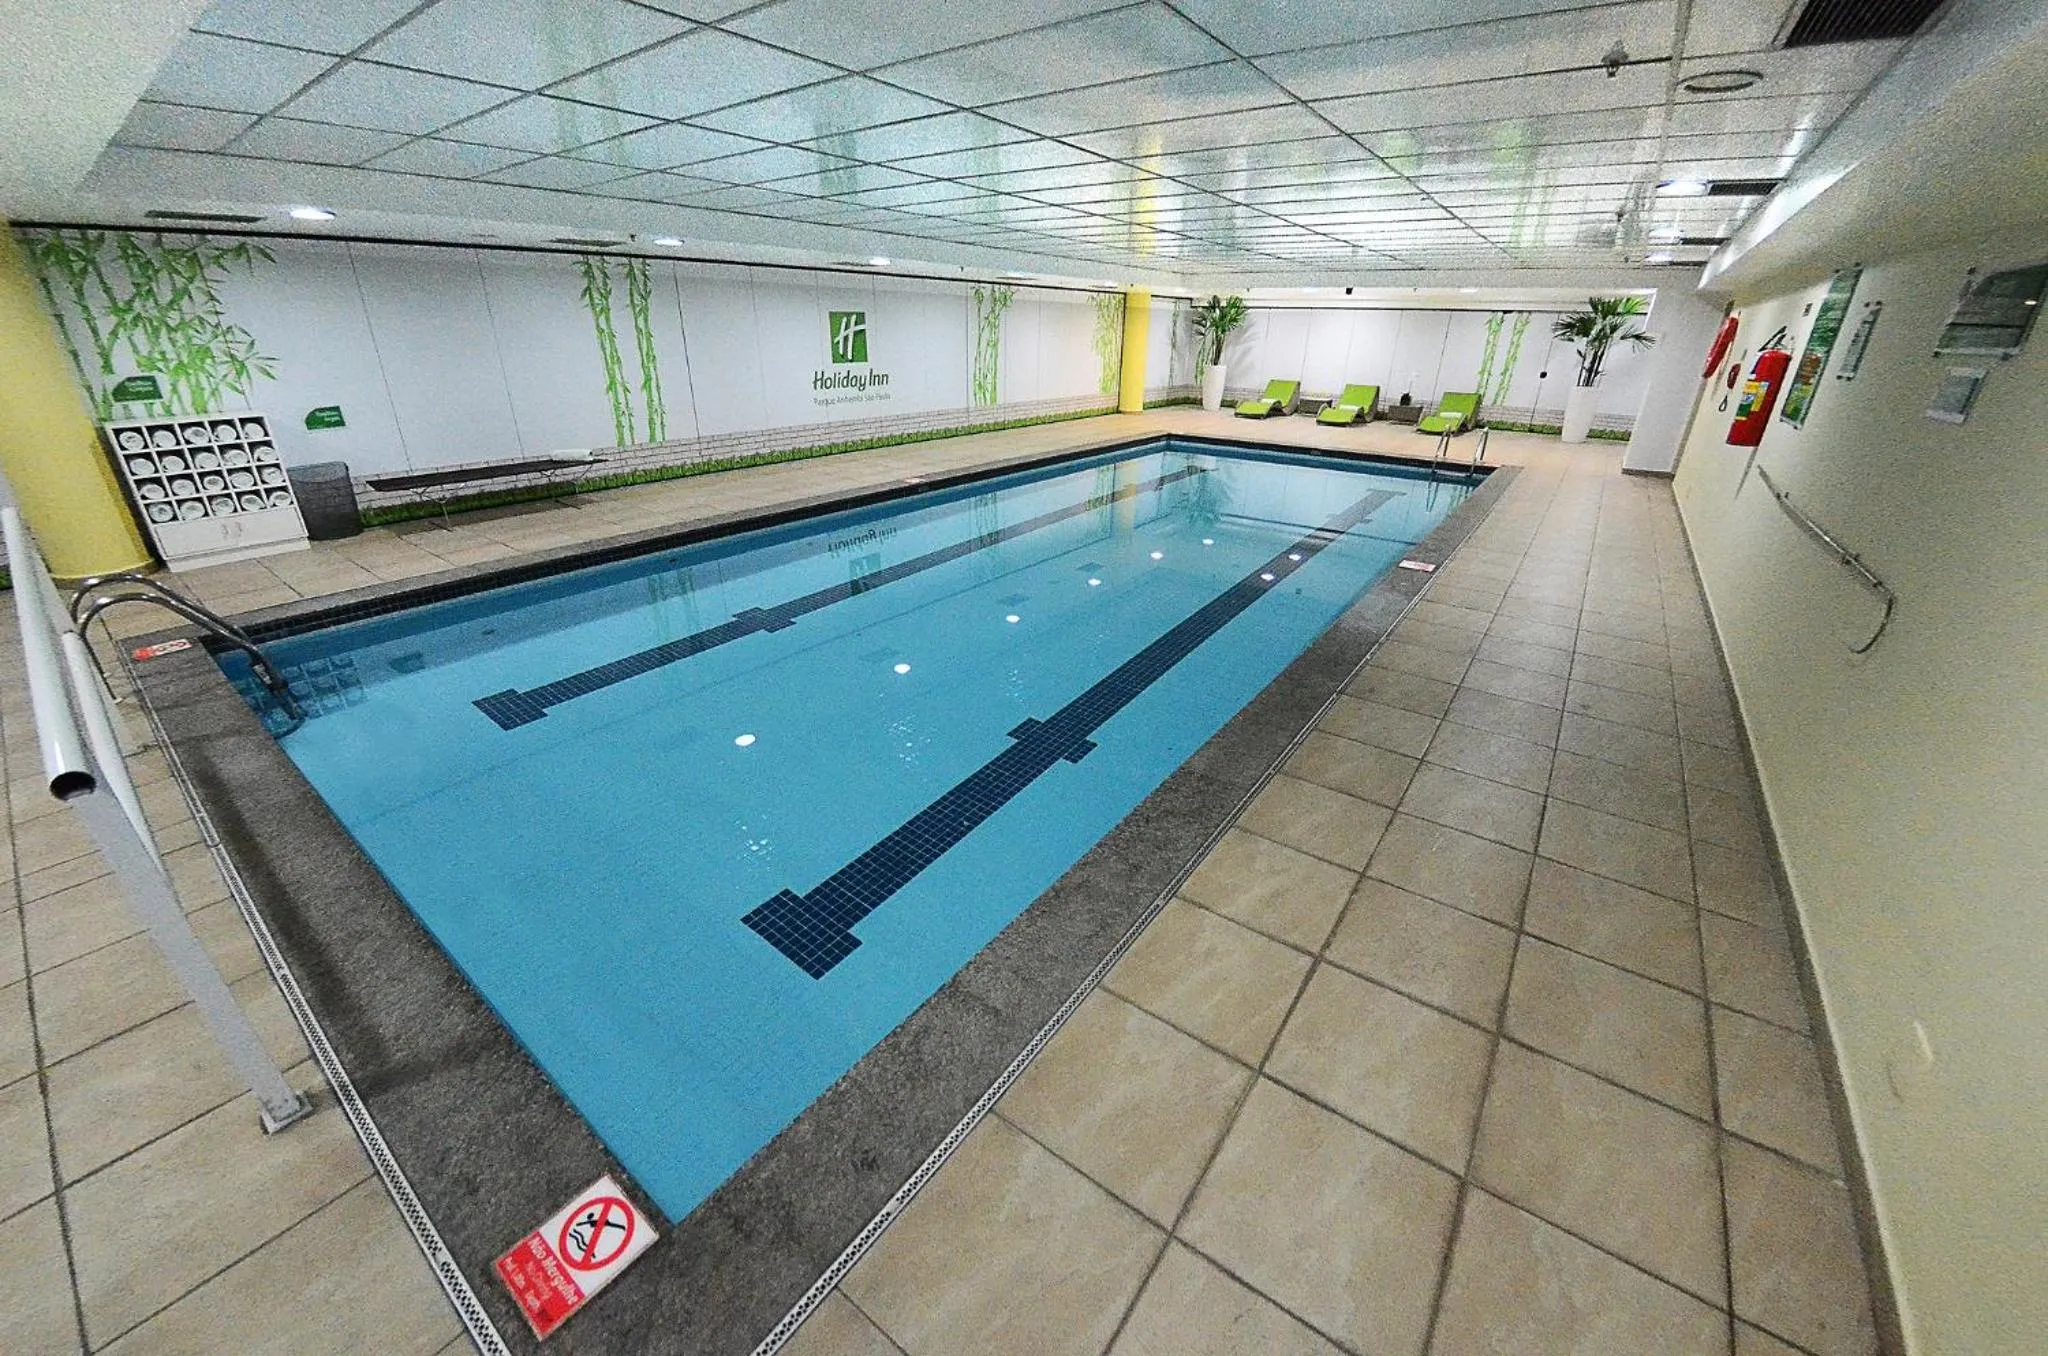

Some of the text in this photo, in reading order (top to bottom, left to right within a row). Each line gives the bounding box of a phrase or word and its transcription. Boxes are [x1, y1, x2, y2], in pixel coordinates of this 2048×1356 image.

[812, 368, 889, 391] Holiday Inn
[527, 1236, 578, 1305] Não Mergulhe
